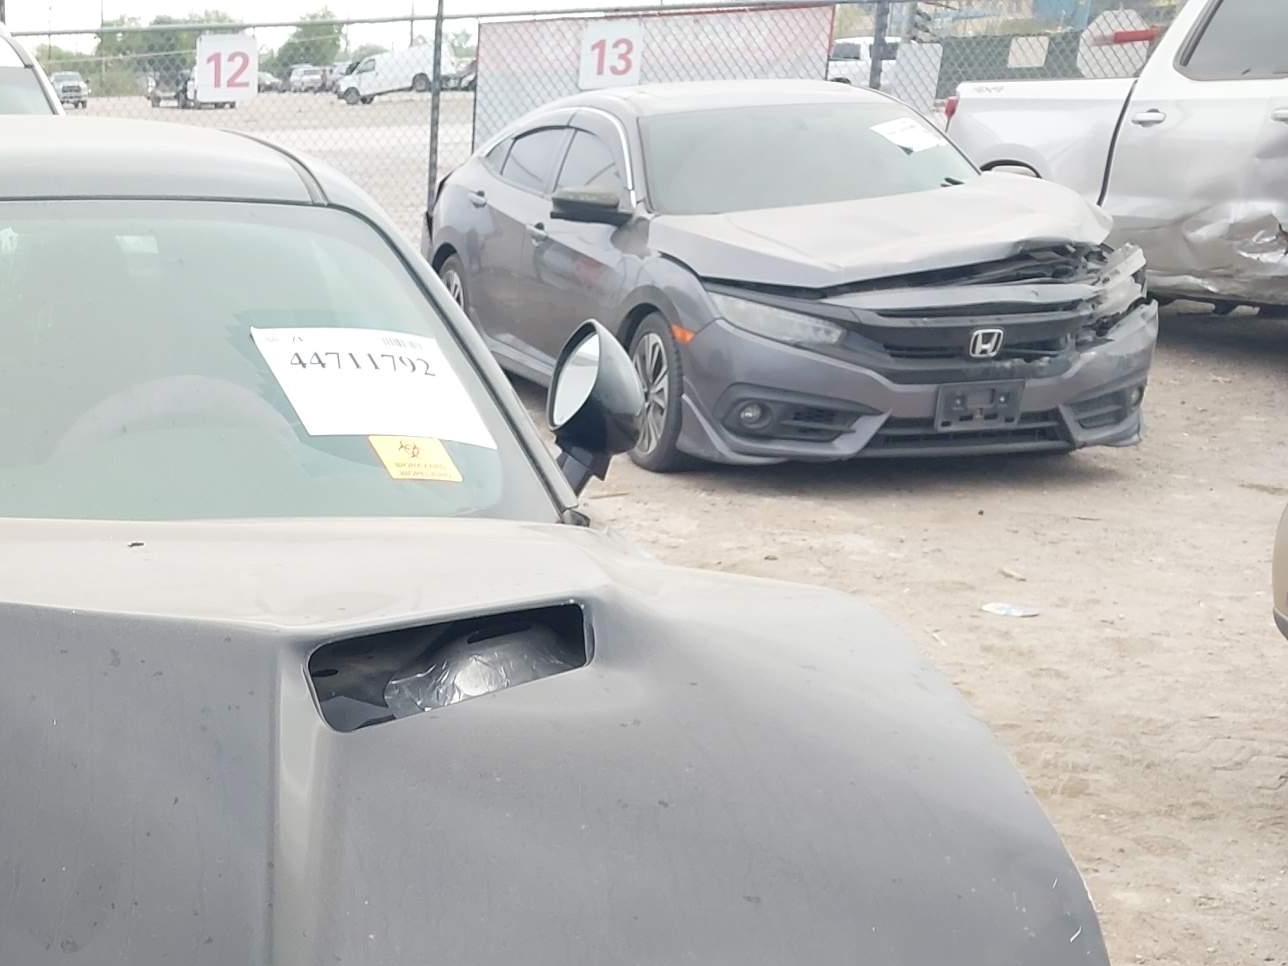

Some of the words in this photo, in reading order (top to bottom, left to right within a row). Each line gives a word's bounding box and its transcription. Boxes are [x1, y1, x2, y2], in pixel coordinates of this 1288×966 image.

[206, 51, 249, 88] 12
[591, 38, 633, 76] 13
[289, 351, 435, 377] 44711792
